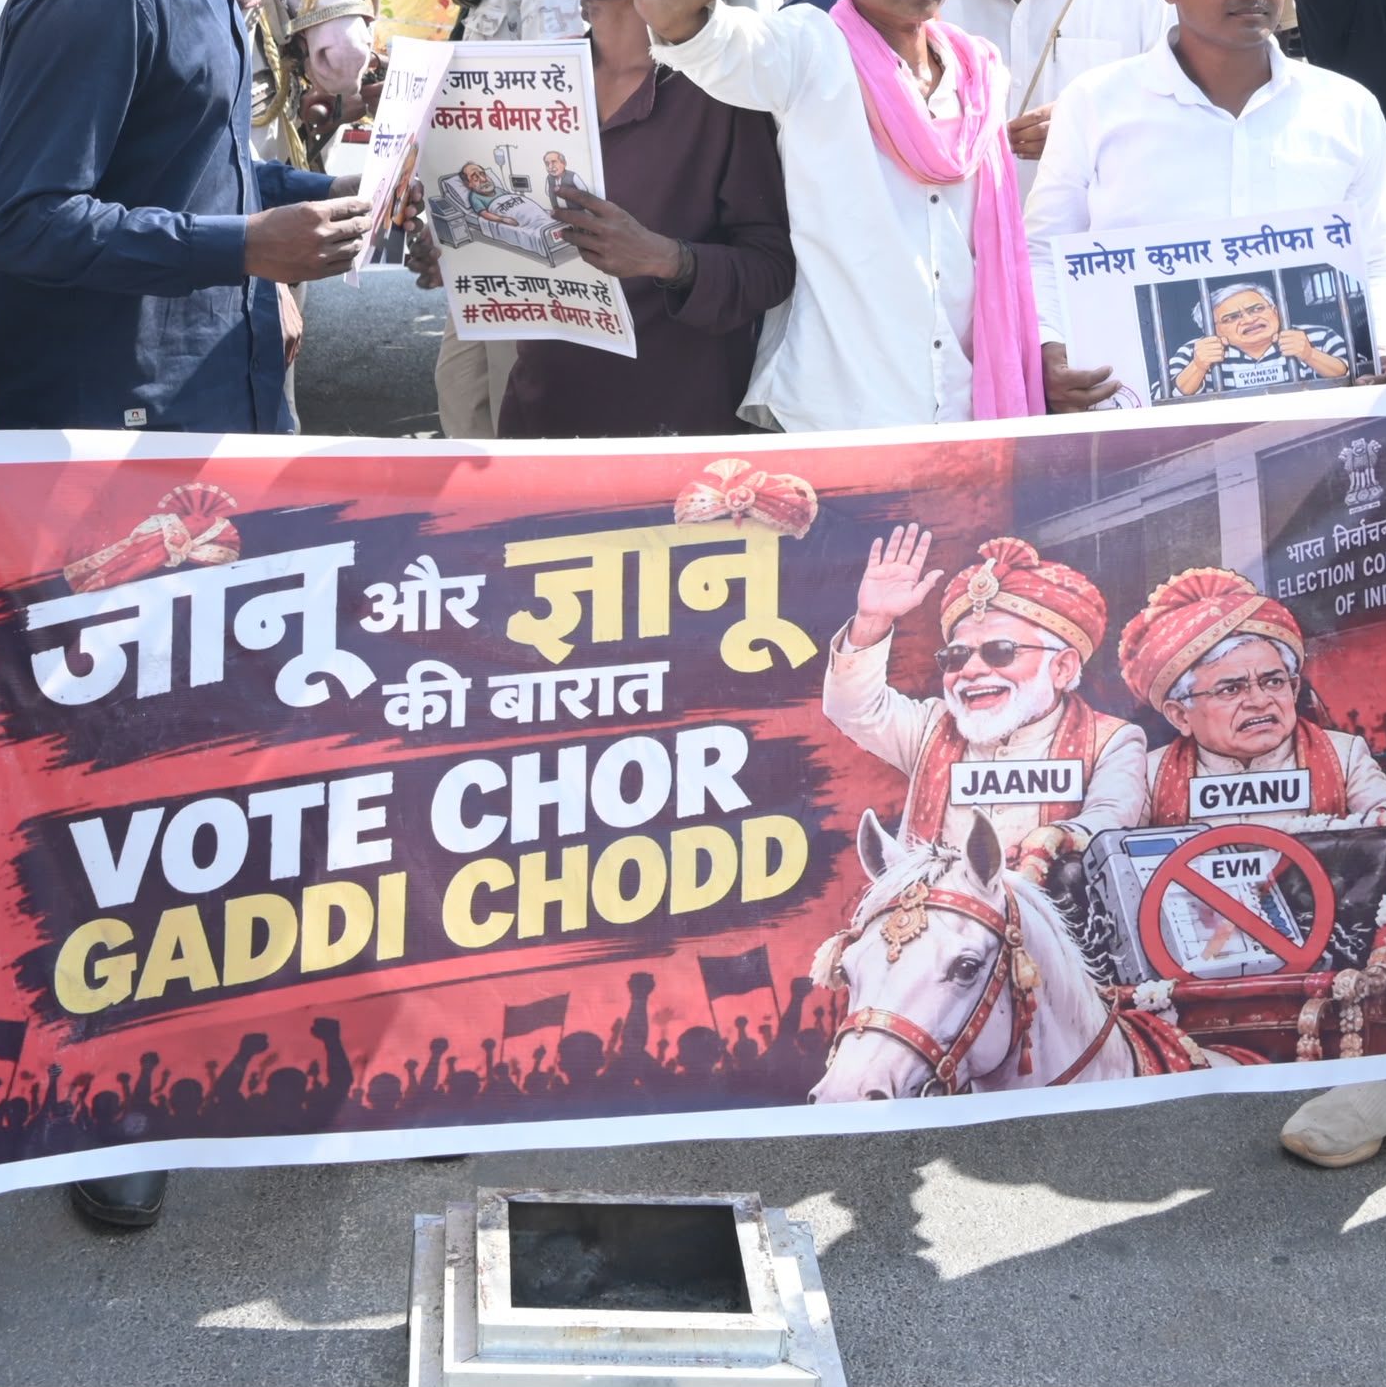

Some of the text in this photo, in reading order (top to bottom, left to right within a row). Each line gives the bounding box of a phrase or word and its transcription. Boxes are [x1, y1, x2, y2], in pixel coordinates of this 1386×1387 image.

[495, 71, 536, 91] अमर
[541, 63, 573, 92] रहें,
[487, 100, 541, 131] बीमार
[547, 100, 580, 133] रहे!
[1065, 214, 1352, 281] ज्ञानेश कुमार इस्तीफा दो
[553, 278, 590, 300] अमर
[548, 299, 591, 329] बीमार
[595, 307, 623, 334] रहे!
[1238, 367, 1279, 380] GYANESH
[1243, 374, 1279, 386] KUMAR
[1286, 536, 1325, 563] भारत
[1277, 560, 1354, 599] ELECTION
[26, 516, 819, 709] जानू और ज्ञानू
[1335, 592, 1355, 616] OF
[380, 660, 669, 732] की बारात
[960, 768, 1072, 797] JAANU
[1199, 778, 1301, 809] GYANU
[69, 724, 752, 910] VOTE CHOR
[1212, 858, 1262, 879] EVM
[54, 814, 809, 1015] GADDI CHODD
